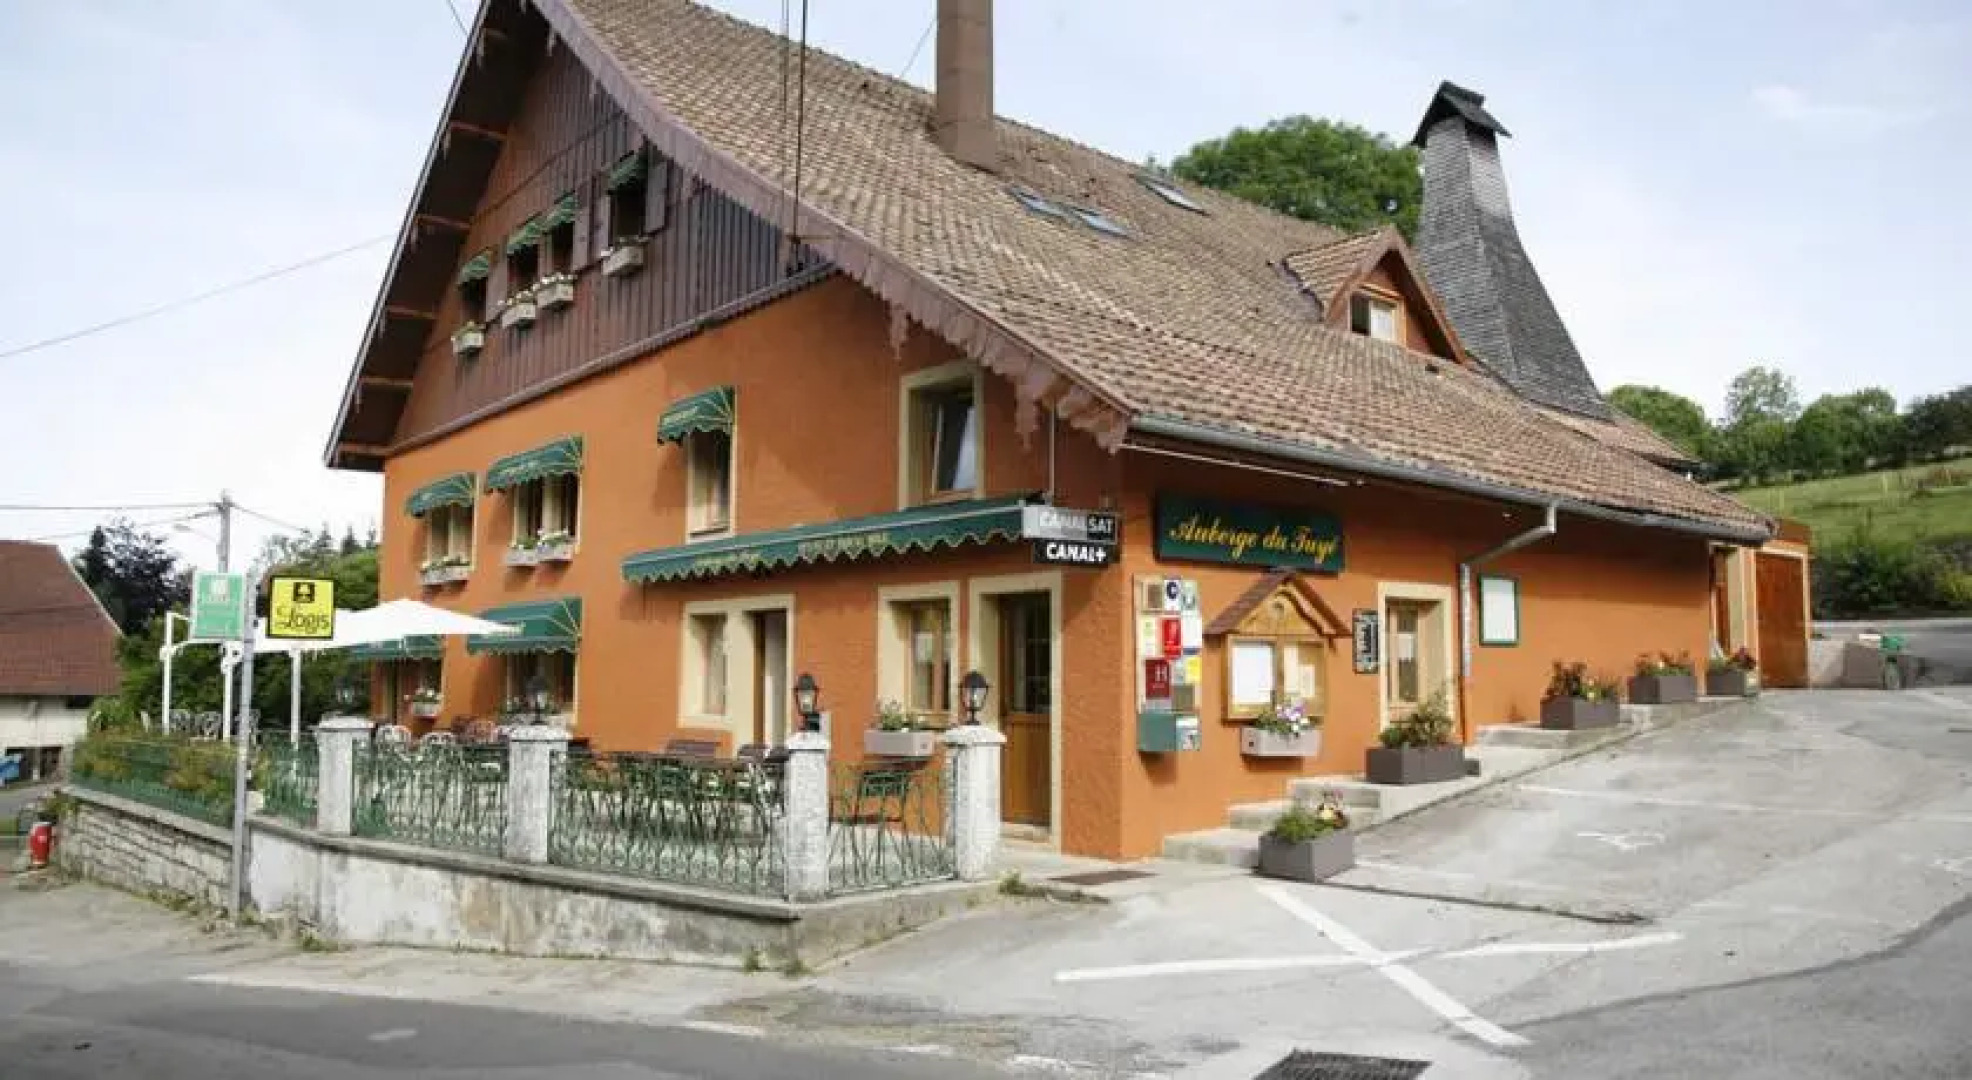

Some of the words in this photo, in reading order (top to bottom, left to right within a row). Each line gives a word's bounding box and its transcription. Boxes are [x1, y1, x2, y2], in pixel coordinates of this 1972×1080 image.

[1046, 542, 1106, 562] CANAL+
[1168, 513, 1258, 559] Auberge
[1263, 526, 1287, 550] du
